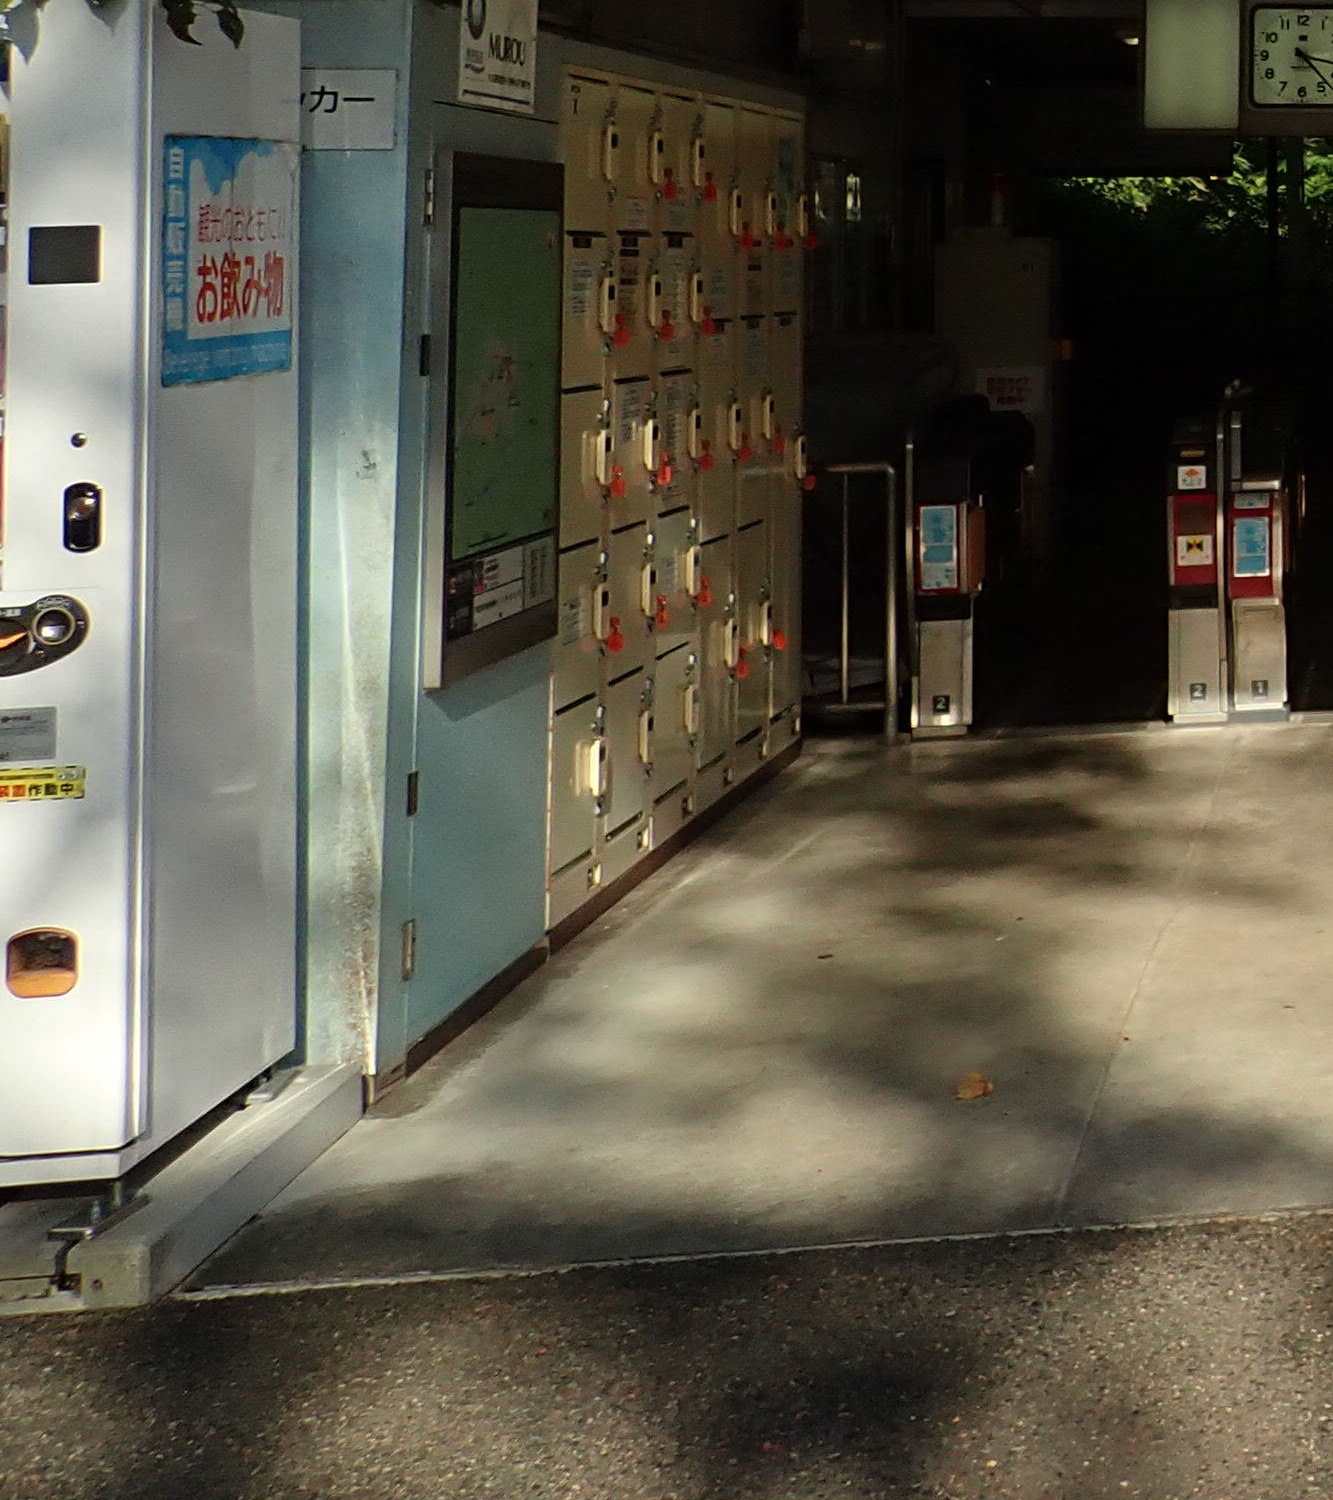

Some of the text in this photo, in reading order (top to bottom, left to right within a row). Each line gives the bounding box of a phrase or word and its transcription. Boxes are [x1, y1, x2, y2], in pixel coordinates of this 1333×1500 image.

[1281, 19, 1289, 30] 11
[1297, 15, 1310, 26] 12
[1265, 32, 1278, 43] 10
[1260, 50, 1269, 61] 9
[1265, 68, 1274, 79] 8
[1279, 81, 1288, 92] 7
[1297, 86, 1307, 97] 6
[1317, 82, 1326, 92] 5
[301, 85, 375, 113] カー
[196, 251, 284, 324] お飲み物
[1193, 684, 1203, 697] 2
[935, 697, 946, 710] 2
